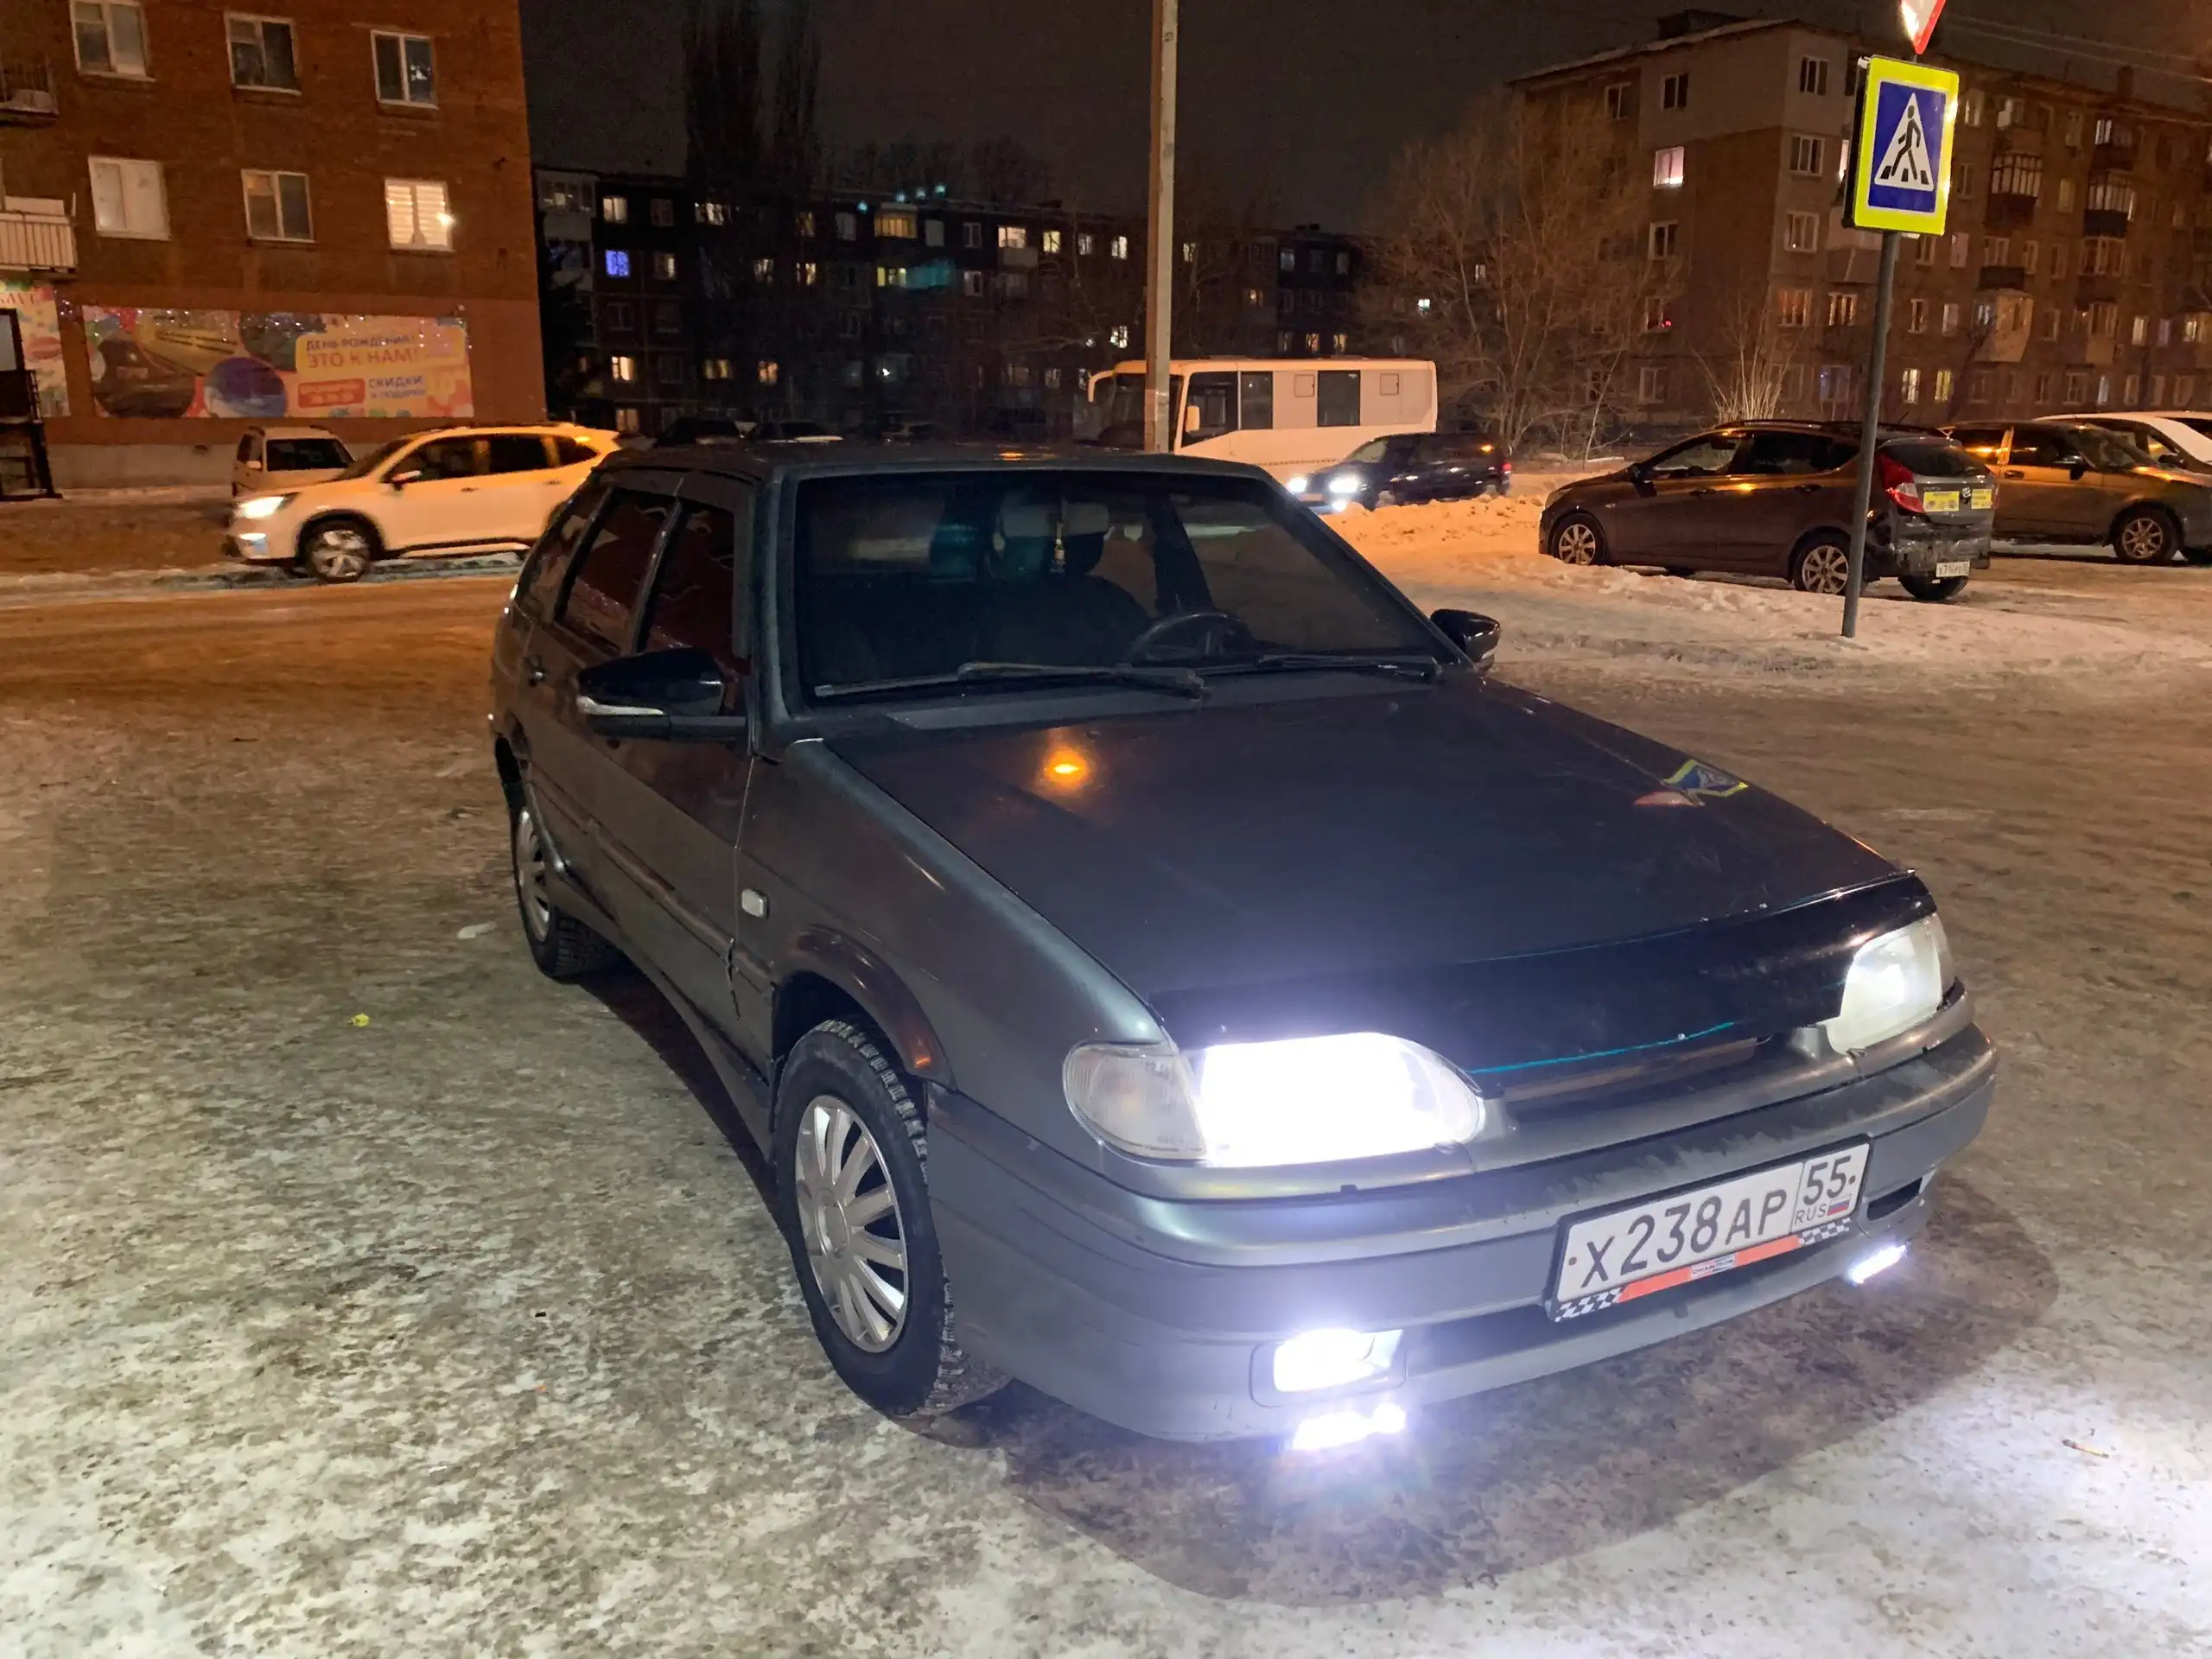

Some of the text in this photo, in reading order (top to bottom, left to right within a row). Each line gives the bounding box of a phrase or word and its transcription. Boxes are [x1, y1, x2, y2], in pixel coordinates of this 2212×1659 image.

[308, 353, 344, 368] ЭТО
[350, 353, 362, 366] К
[368, 376, 423, 389] СКИДКИ
[1803, 1155, 1852, 1205] 55
[1794, 1203, 1827, 1225] RUS
[1581, 1189, 1787, 1288] Х238АР
